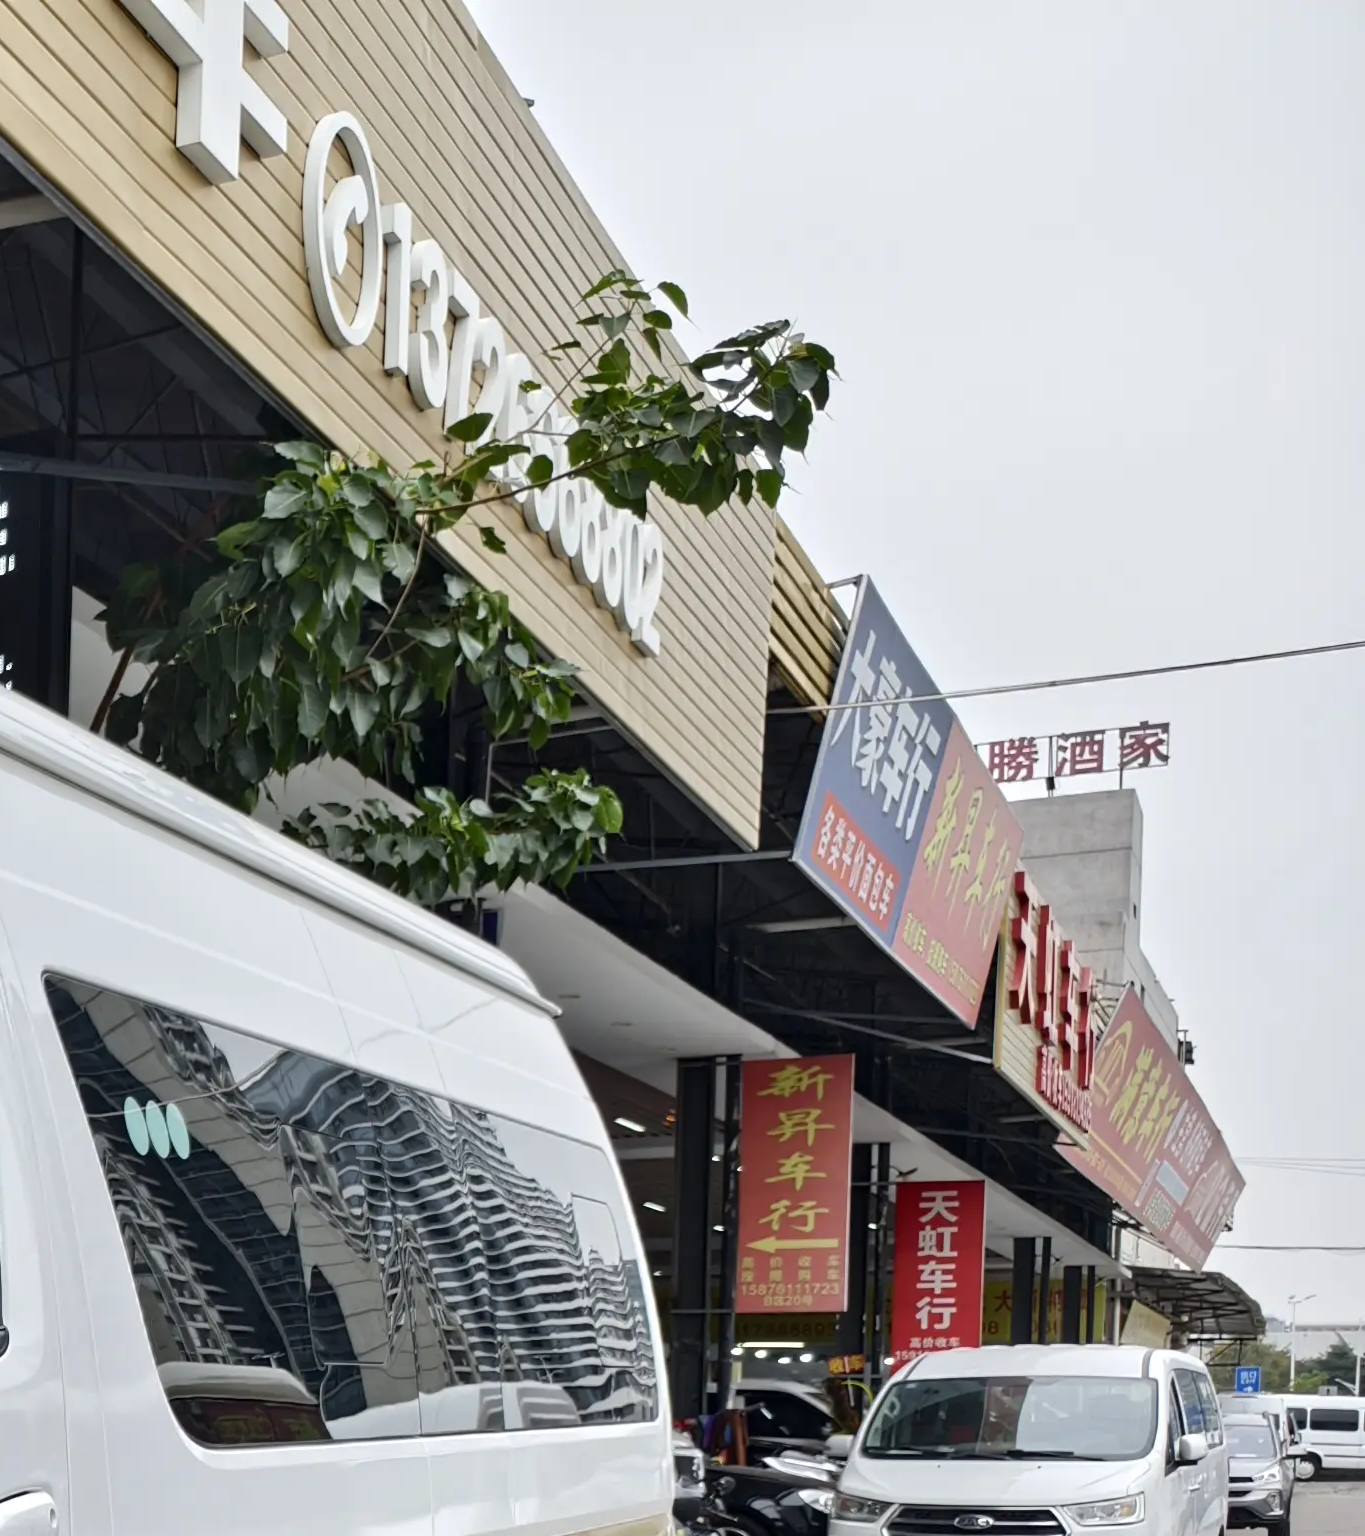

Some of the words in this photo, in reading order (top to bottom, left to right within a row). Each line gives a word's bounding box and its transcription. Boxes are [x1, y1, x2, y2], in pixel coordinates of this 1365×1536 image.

[831, 630, 941, 841] 大豪车行
[987, 720, 1170, 784] 勝酒家
[915, 1190, 961, 1331] 天虹车行
